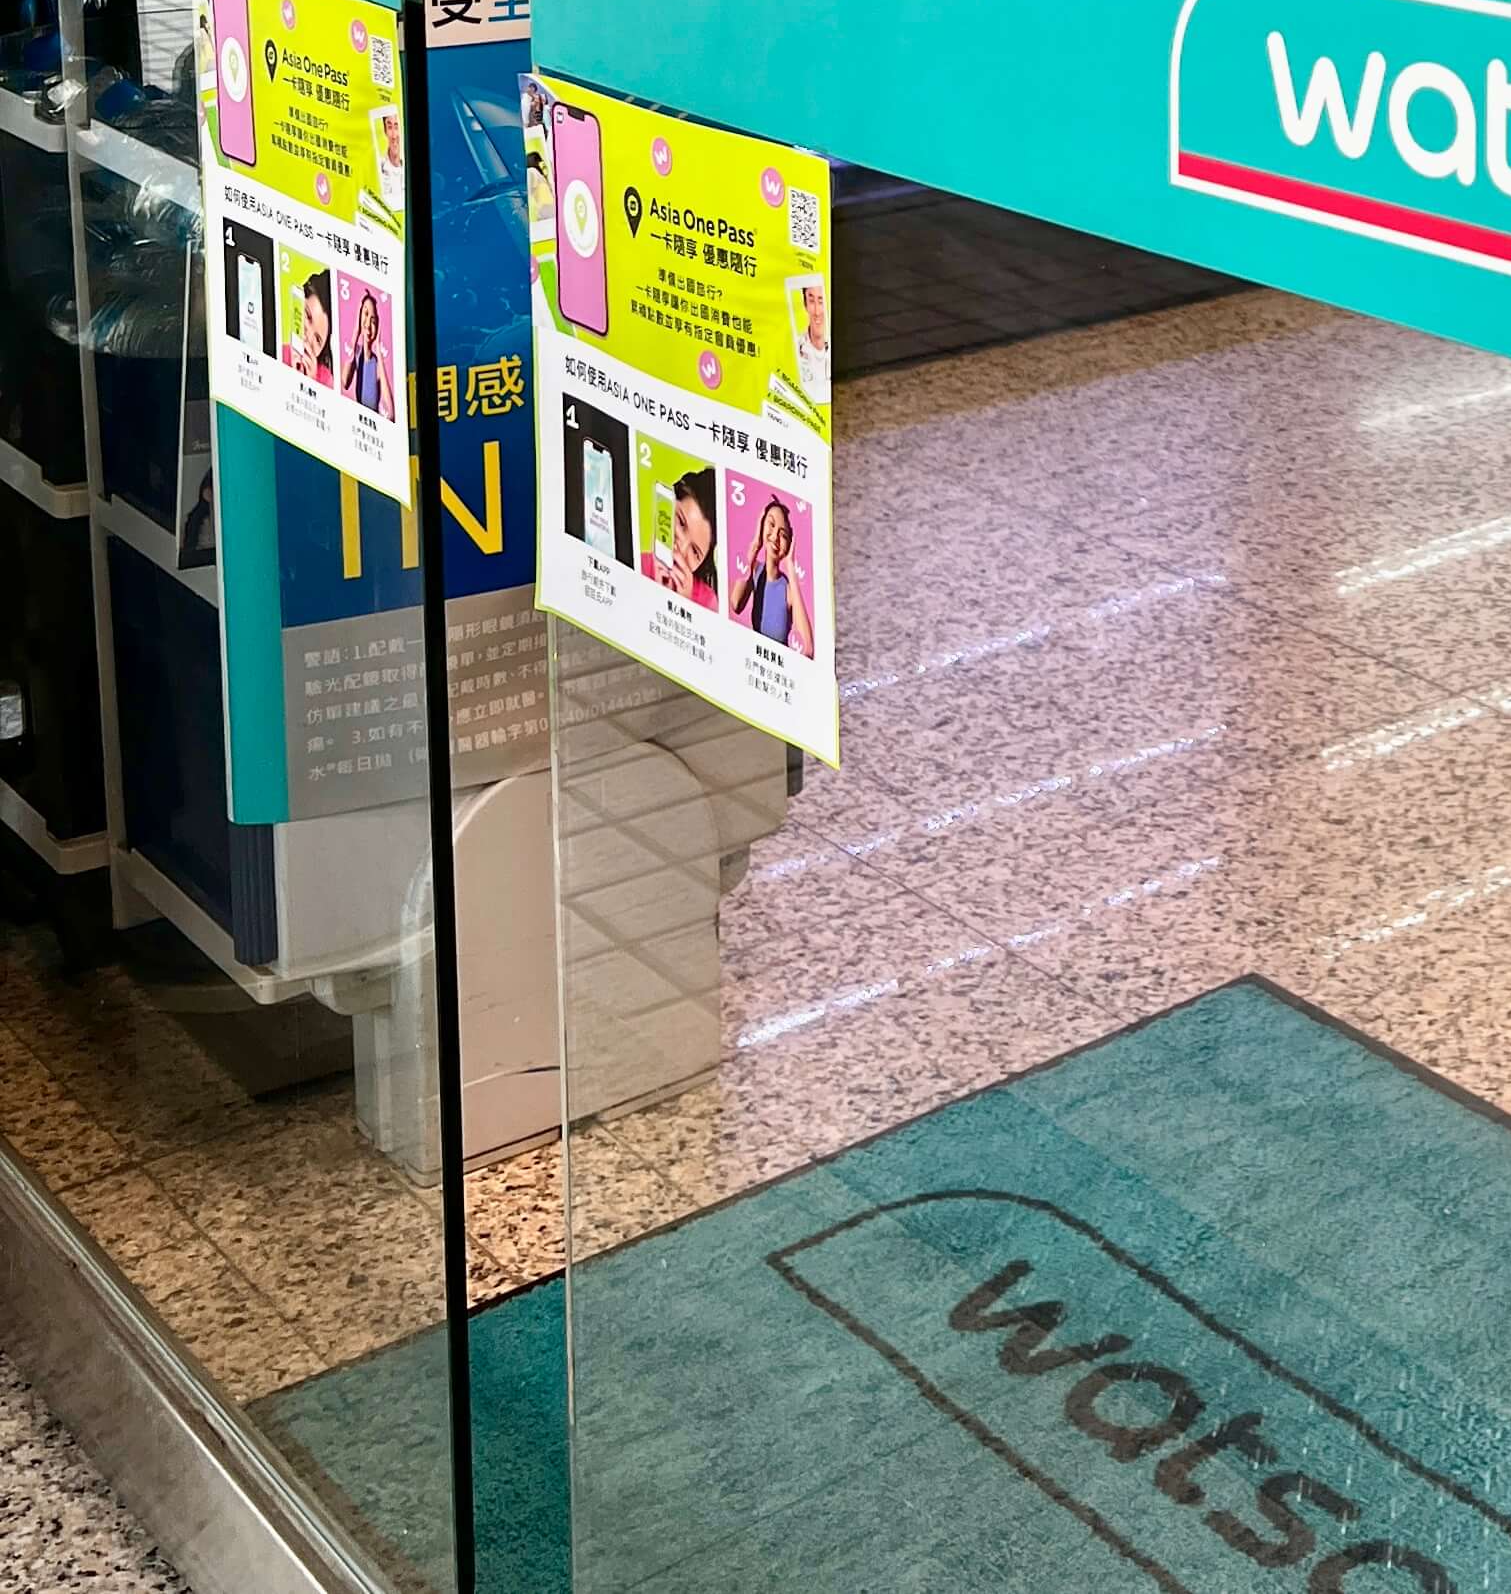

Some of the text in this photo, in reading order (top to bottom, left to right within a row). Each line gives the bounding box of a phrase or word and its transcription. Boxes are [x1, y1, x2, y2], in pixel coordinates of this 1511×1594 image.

[282, 48, 302, 70] Asia
[303, 57, 323, 79] One
[649, 197, 681, 226] Asia
[683, 208, 715, 237] One
[650, 230, 698, 260] 一卡隨享
[702, 242, 758, 278] 優惠隨行
[566, 404, 579, 430] 1
[633, 391, 657, 418] ONE
[659, 403, 690, 431] PASS
[694, 422, 750, 454] 一卡隨享
[754, 436, 808, 479] 優惠隨行
[639, 442, 653, 469] 2
[730, 480, 746, 507] 3
